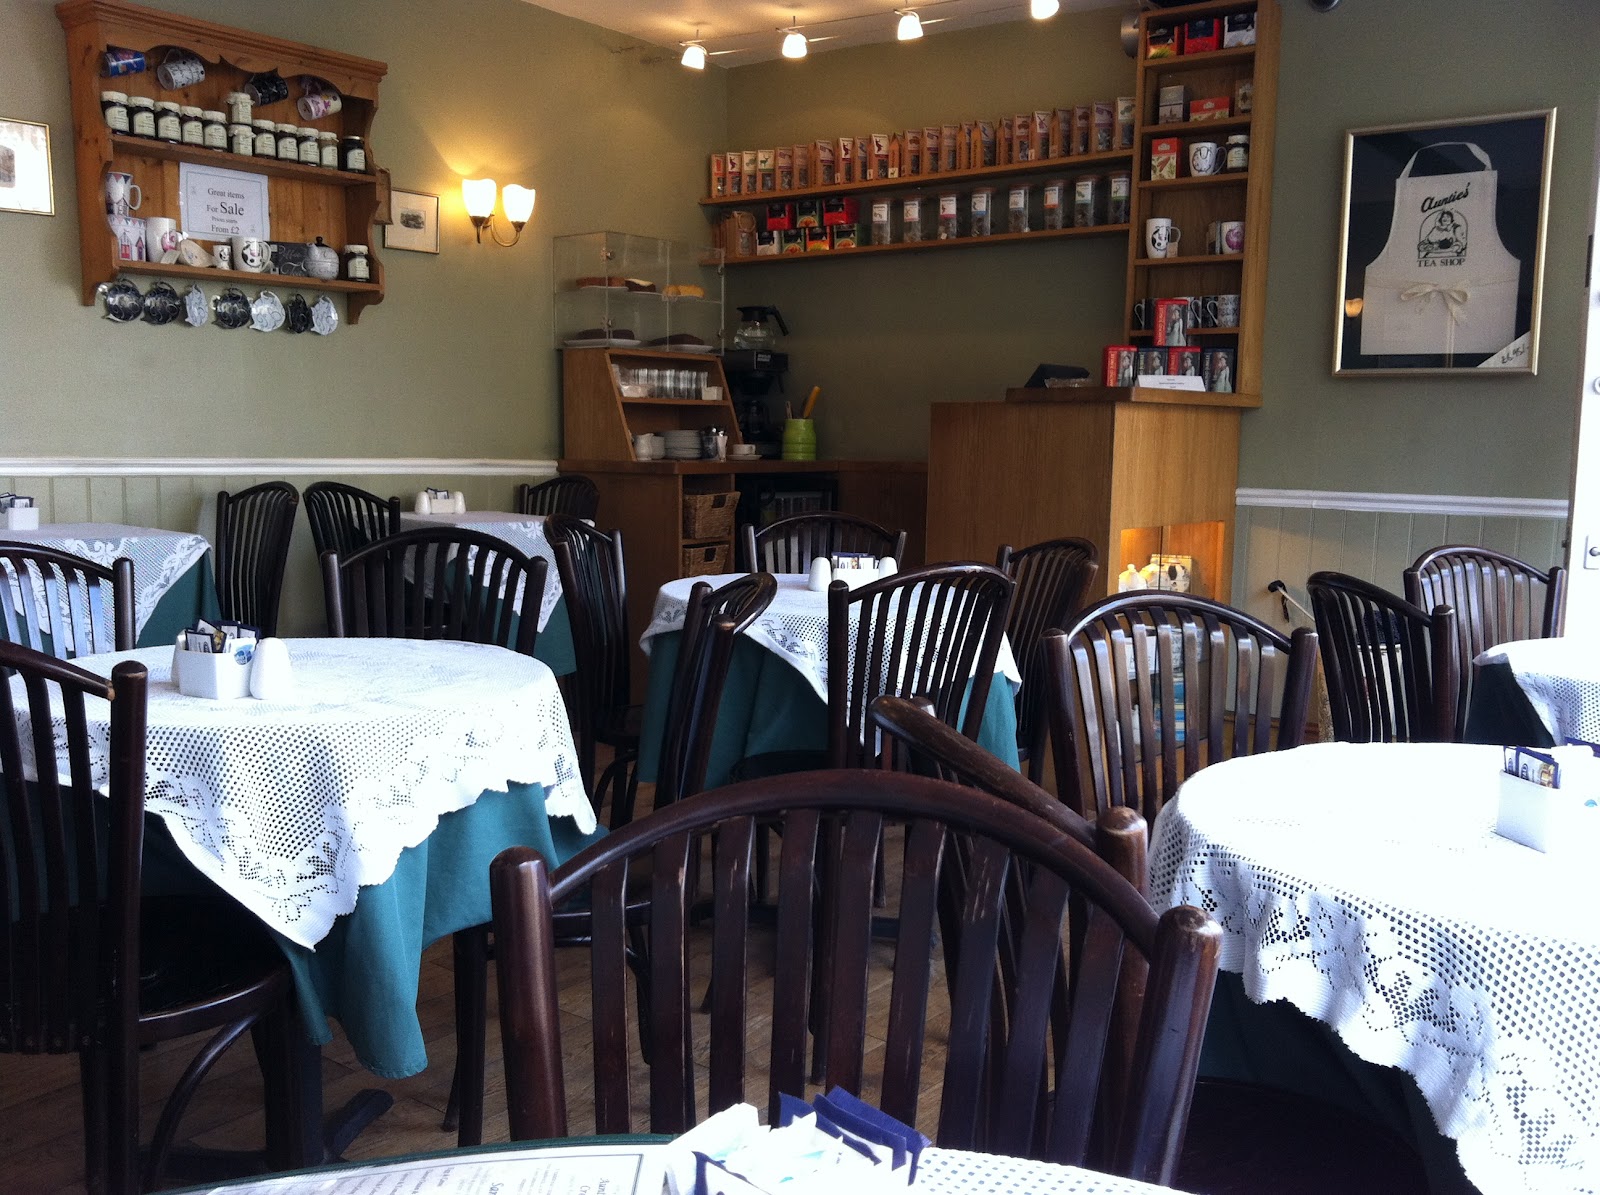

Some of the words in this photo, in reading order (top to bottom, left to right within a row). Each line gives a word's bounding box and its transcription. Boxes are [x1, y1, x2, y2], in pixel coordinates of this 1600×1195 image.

[207, 187, 226, 197] Great
[227, 190, 245, 199] items
[206, 204, 218, 213] For
[220, 201, 244, 216] Sale
[211, 224, 229, 233] From
[230, 226, 240, 234] £2
[1417, 259, 1436, 267] TEA
[1440, 258, 1465, 267] SHOP
